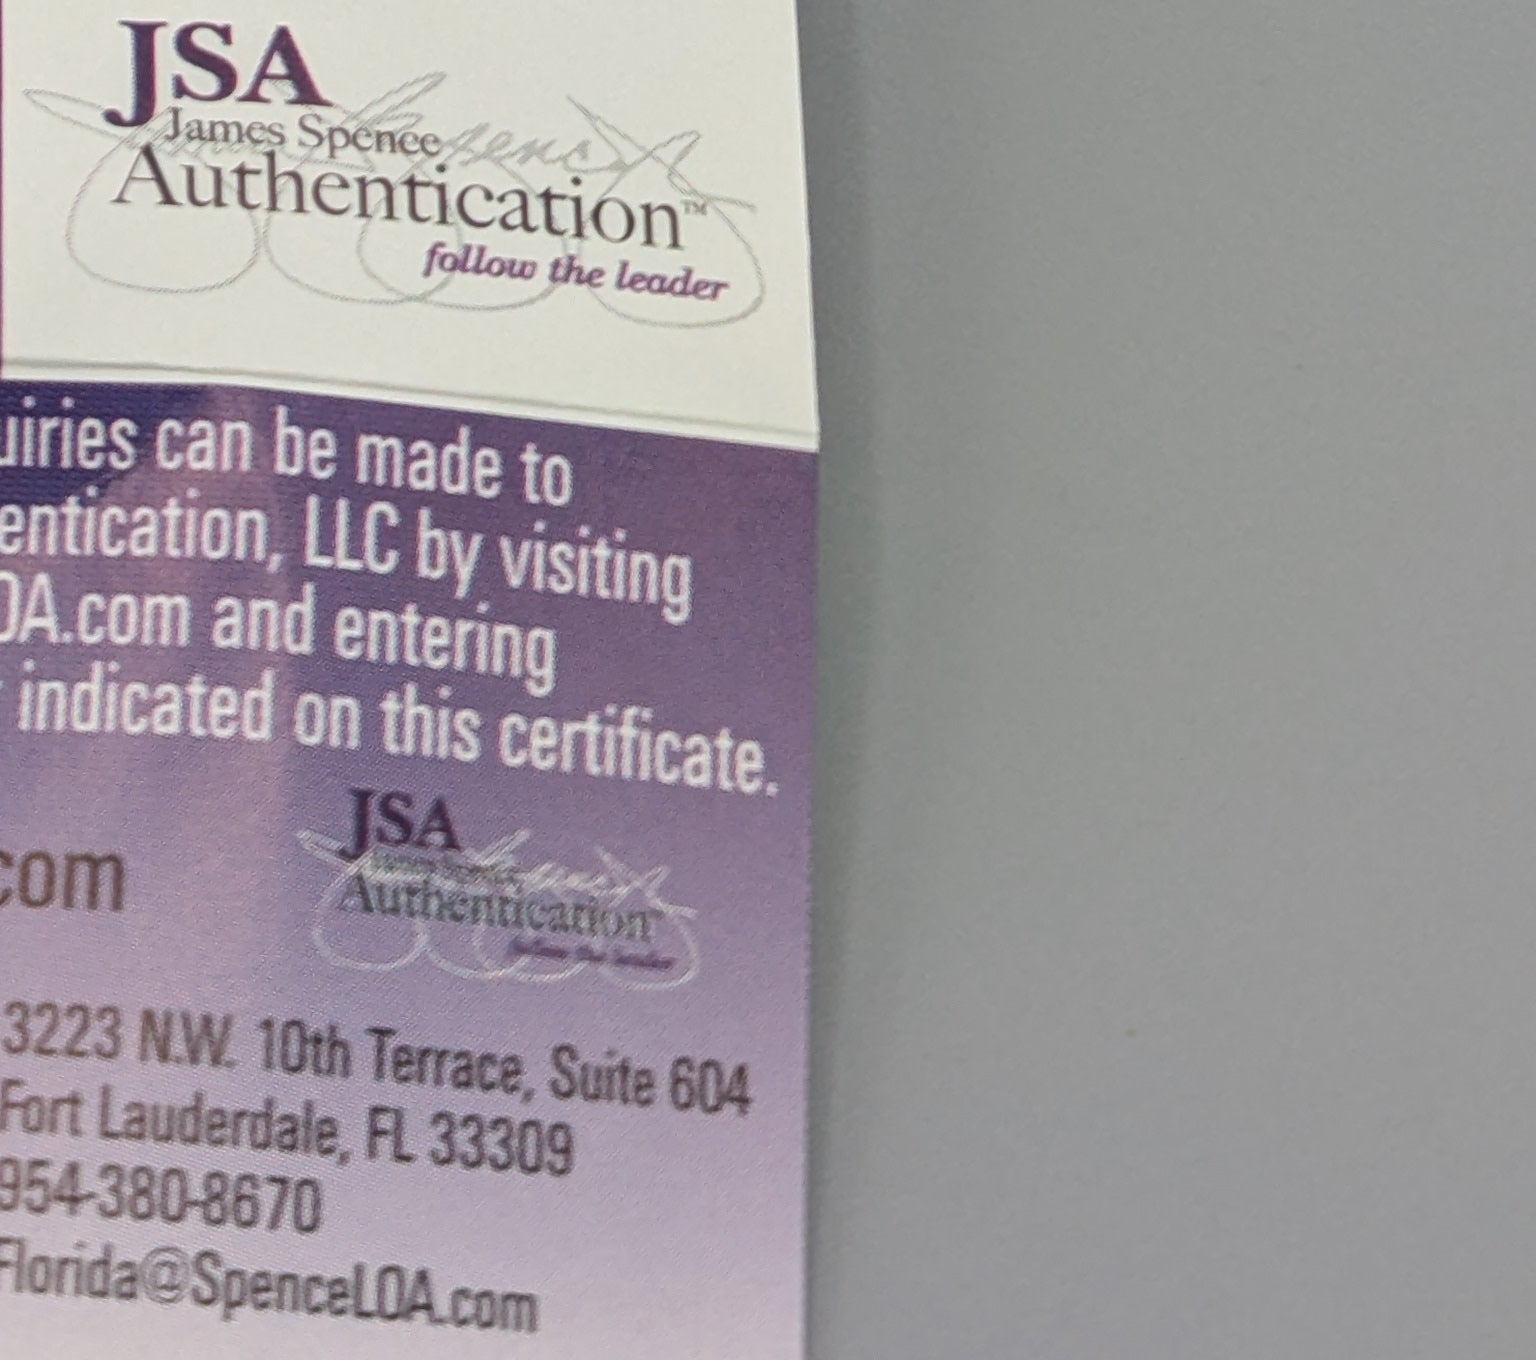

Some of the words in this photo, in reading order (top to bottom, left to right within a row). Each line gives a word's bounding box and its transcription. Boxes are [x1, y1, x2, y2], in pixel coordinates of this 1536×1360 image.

[104, 19, 334, 129] JSA
[164, 106, 286, 148] James
[297, 113, 441, 159] Spence
[421, 241, 538, 281] follow
[547, 254, 606, 290] the
[614, 261, 730, 304] leader
[156, 416, 252, 474] can
[273, 405, 337, 480] be
[356, 425, 503, 502] made
[521, 443, 573, 508] to
[303, 493, 400, 574] LLC
[416, 505, 485, 598] by
[499, 520, 693, 626] visiting
[212, 584, 316, 656] and
[334, 601, 557, 699] entering
[17, 658, 275, 741] indicated
[294, 692, 361, 749] on
[381, 680, 483, 764] this
[498, 703, 781, 797] certificate.
[338, 787, 463, 862] JSA
[1, 1000, 123, 1061] 3223
[140, 1010, 237, 1069] N.W.
[260, 1018, 351, 1080] 10th
[367, 1026, 536, 1104] Terrace,
[550, 1042, 656, 1107] Suite
[670, 1055, 754, 1117] 604
[99, 1085, 352, 1168] Lauderdale,
[365, 1106, 412, 1165] FL
[429, 1112, 575, 1177] 33309
